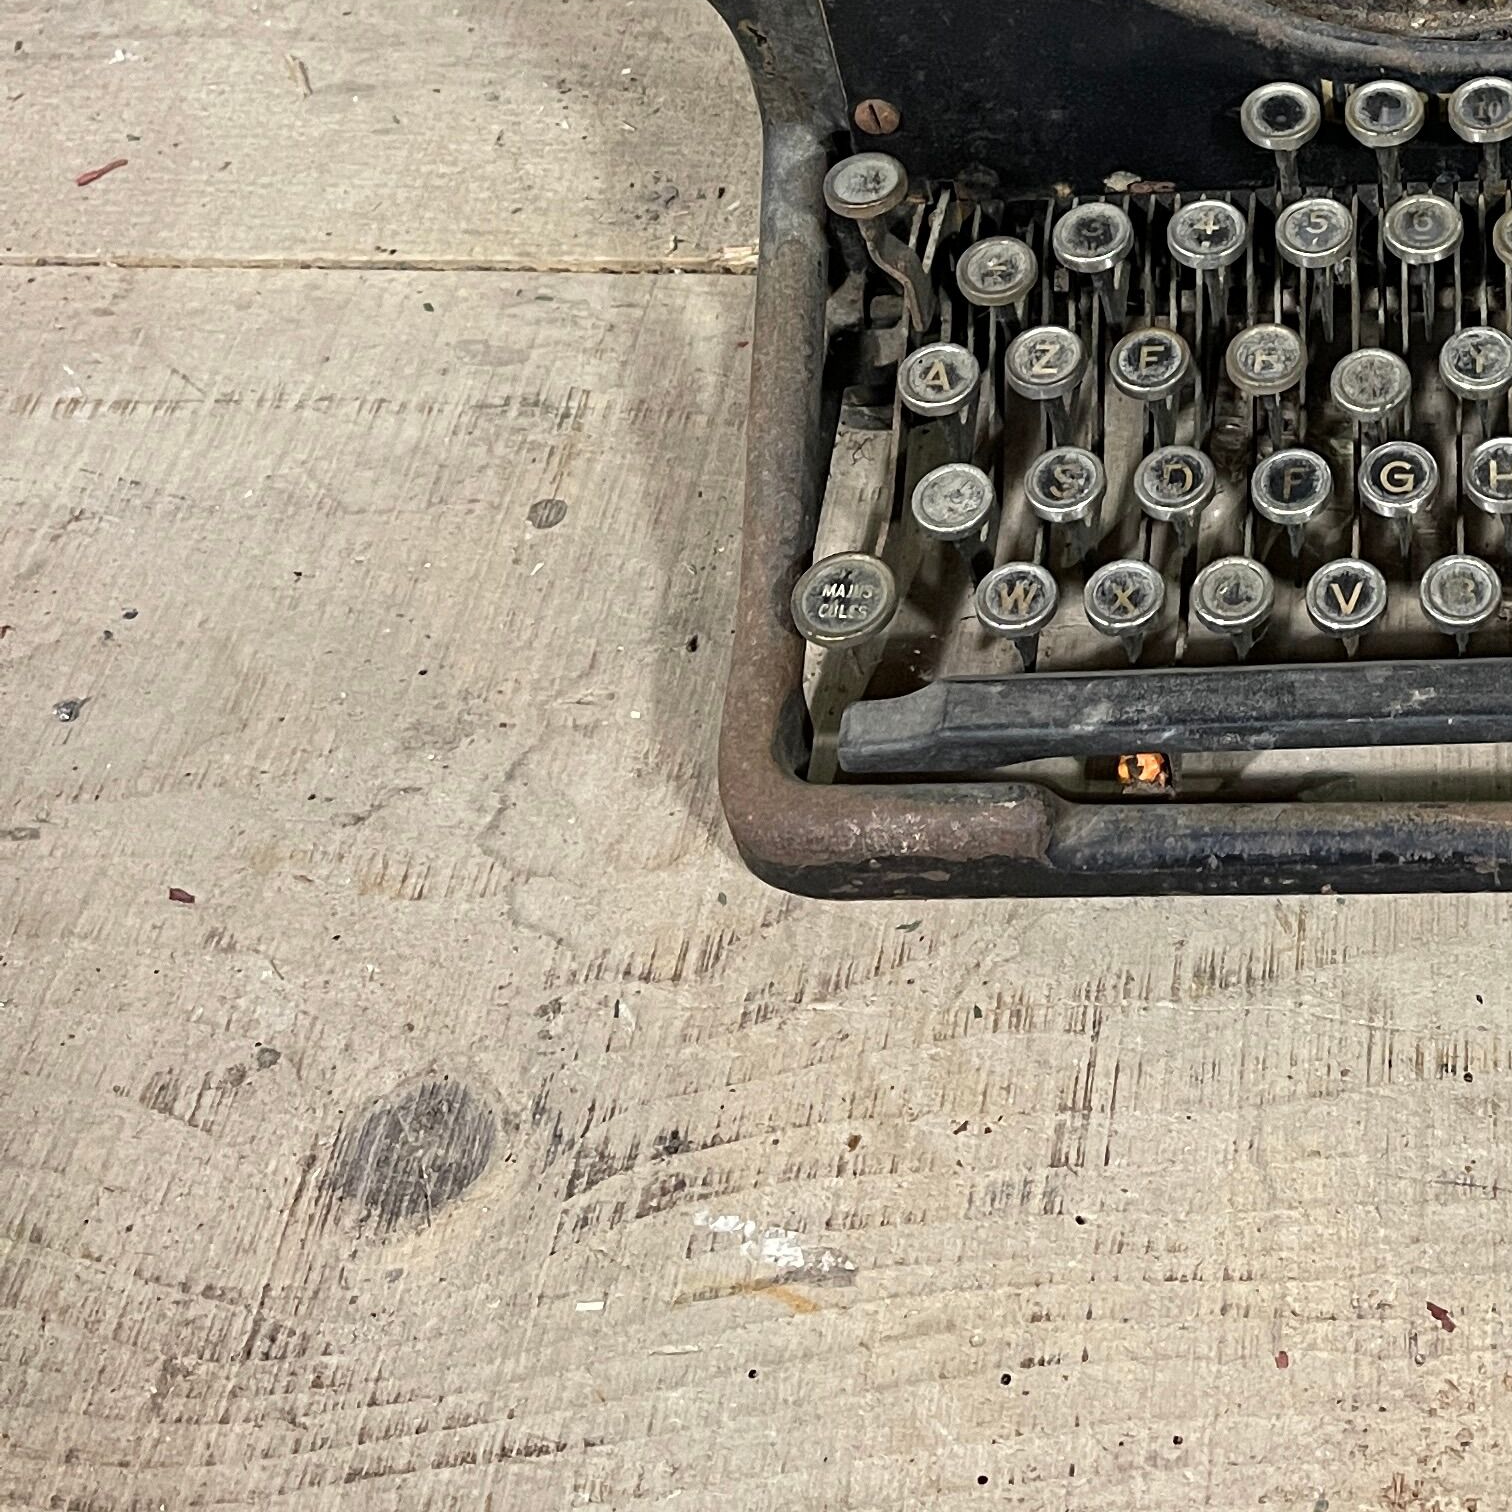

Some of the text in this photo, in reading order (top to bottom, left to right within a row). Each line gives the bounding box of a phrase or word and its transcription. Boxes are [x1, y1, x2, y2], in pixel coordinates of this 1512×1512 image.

[1306, 210, 1335, 234] 5
[922, 359, 950, 392] A
[1031, 343, 1060, 376] Z
[1050, 463, 1084, 499] S
[1163, 463, 1194, 493] D
[1283, 466, 1309, 500] F
[1380, 460, 1415, 493] G
[1000, 581, 1038, 615] W
[1110, 582, 1138, 614] X
[1330, 579, 1365, 616] V
